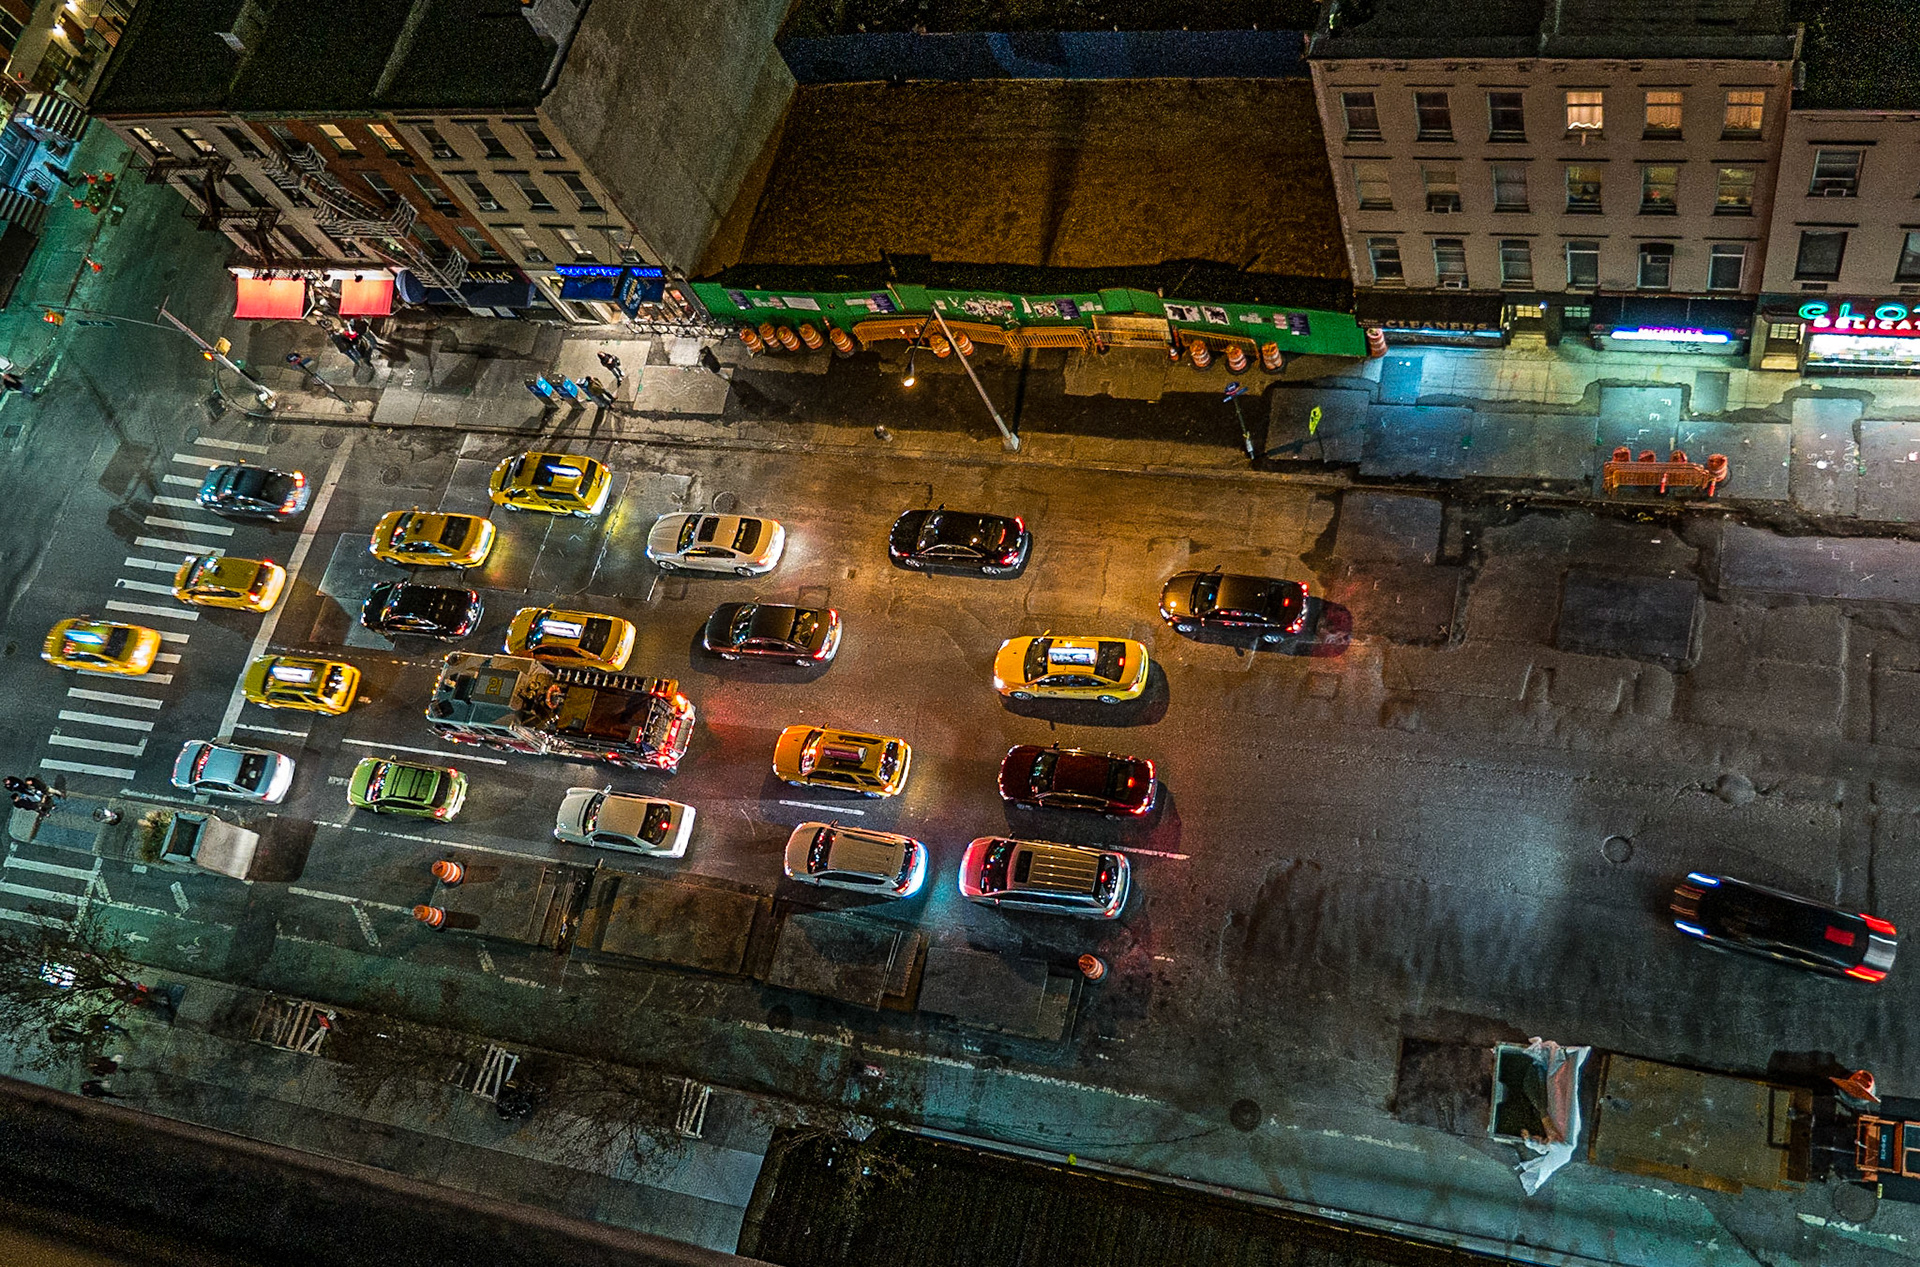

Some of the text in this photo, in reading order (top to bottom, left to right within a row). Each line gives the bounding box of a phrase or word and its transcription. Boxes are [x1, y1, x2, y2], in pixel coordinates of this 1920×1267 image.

[1798, 299, 1920, 321] CLO
[1385, 319, 1488, 331] CLEANERS
[485, 676, 504, 695] 21
